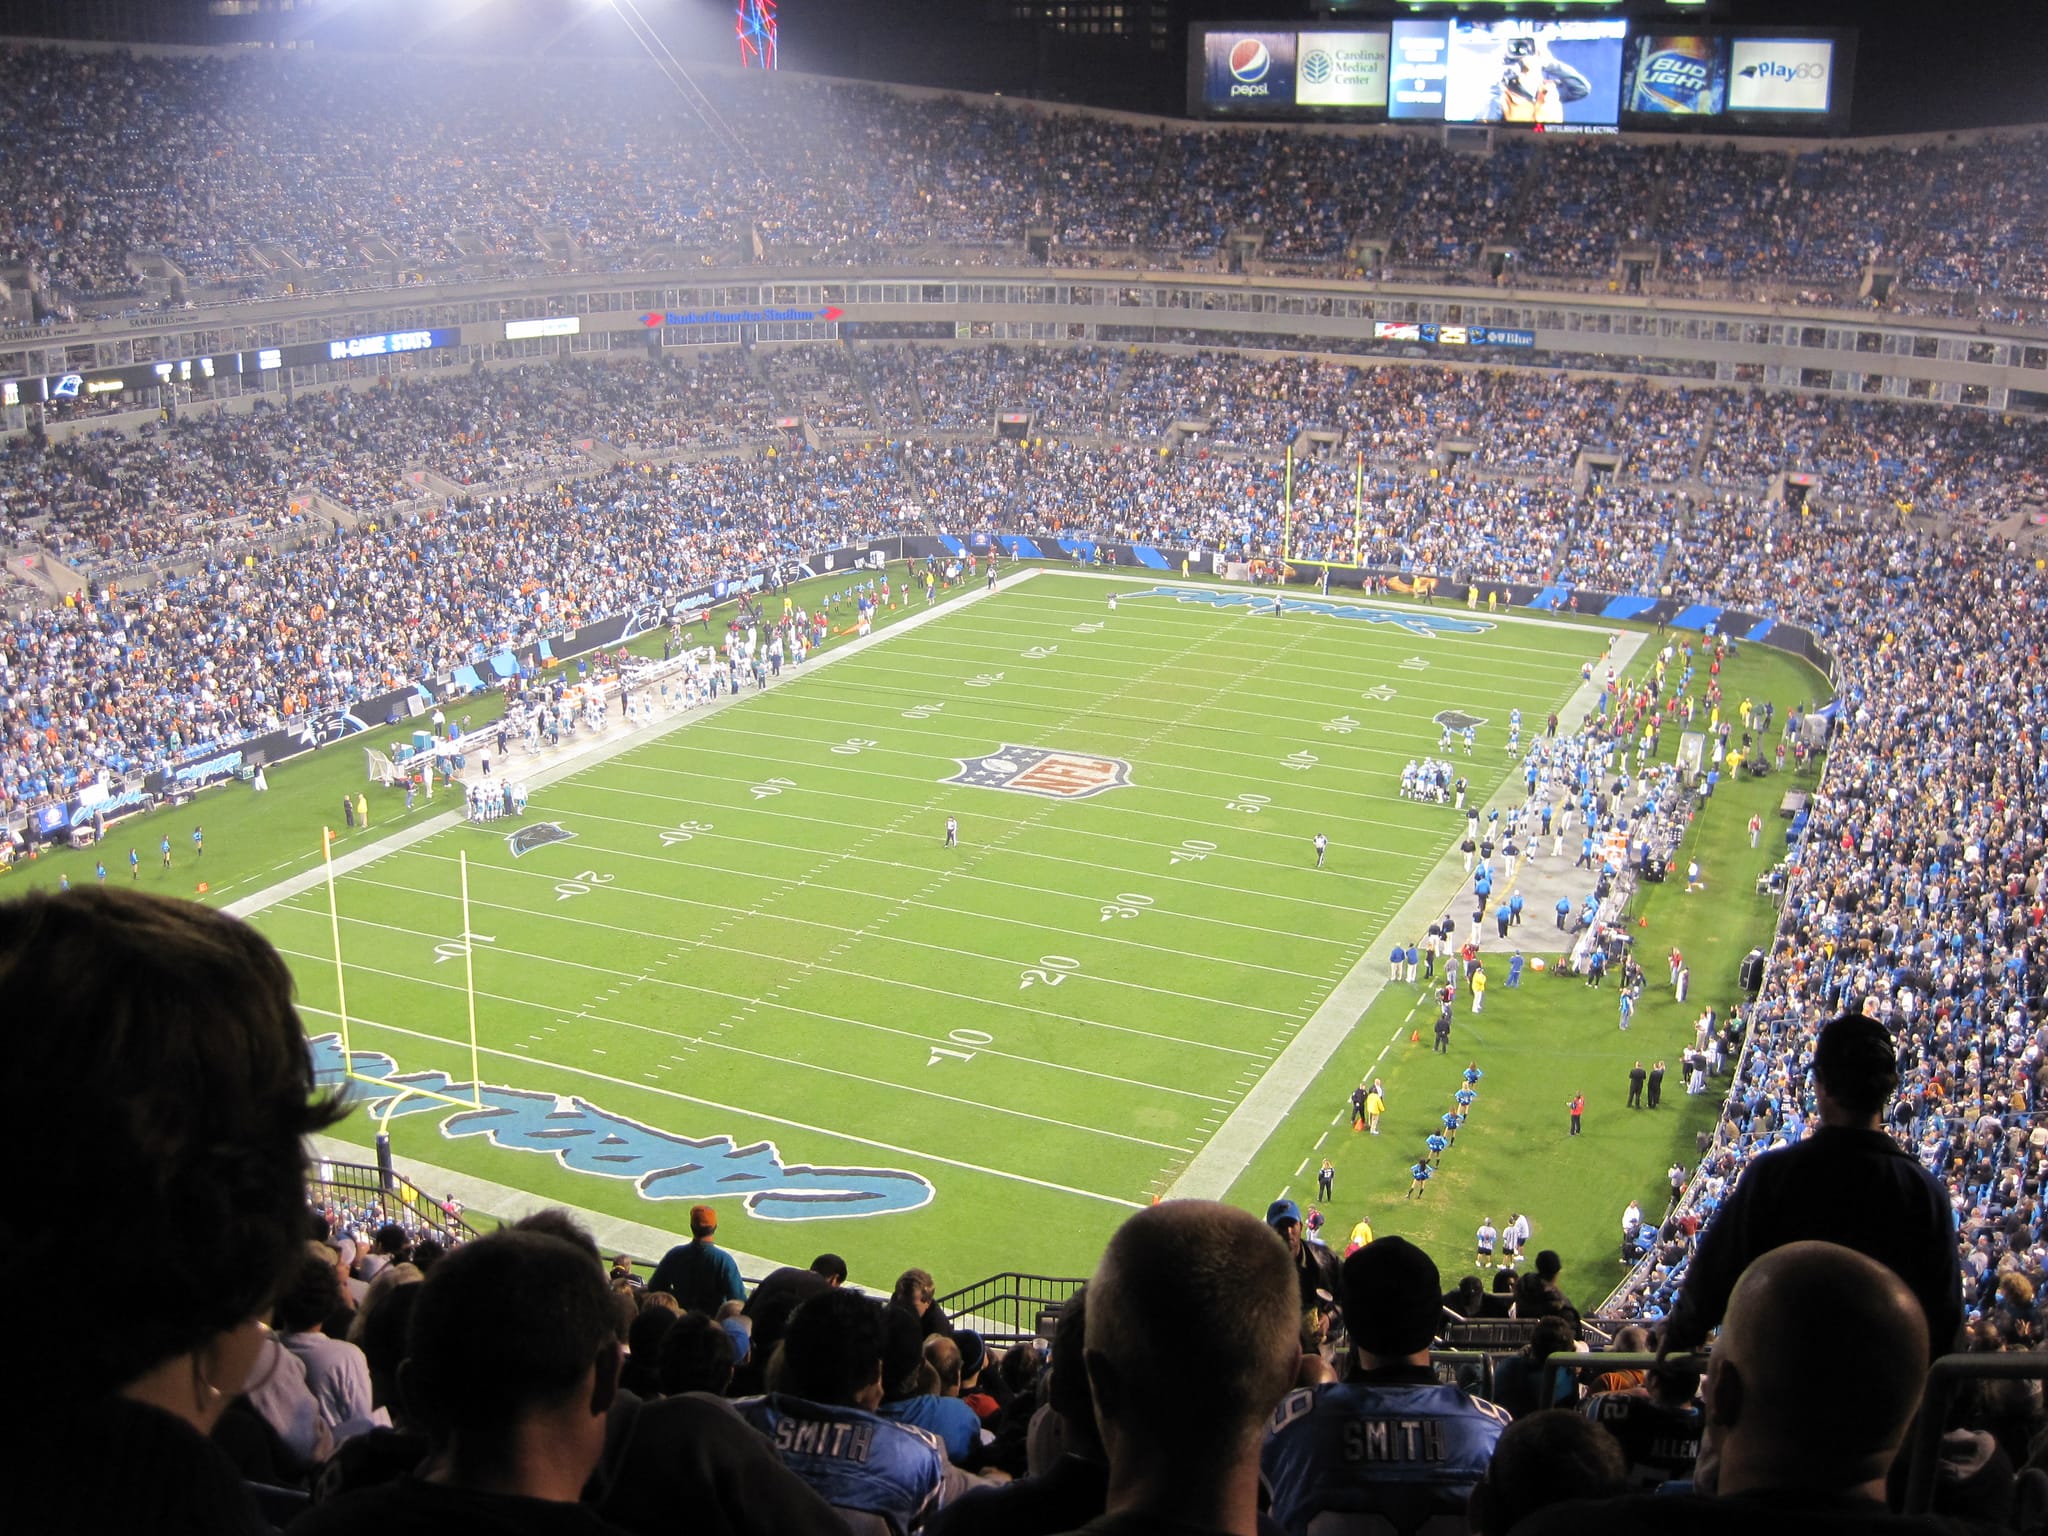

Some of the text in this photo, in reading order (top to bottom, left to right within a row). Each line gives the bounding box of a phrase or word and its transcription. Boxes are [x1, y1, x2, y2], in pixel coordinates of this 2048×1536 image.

[1335, 50, 1385, 61] Carolinas
[1335, 62, 1378, 73] Medical
[1652, 58, 1707, 78] BUD
[1231, 83, 1269, 97] pepsi
[1335, 75, 1369, 85] Center
[1643, 70, 1708, 90] LIGHT
[666, 311, 699, 325] Bank
[713, 310, 762, 324] America
[764, 308, 815, 321] Stadium
[1506, 332, 1534, 345] Blue
[1361, 686, 1397, 701] 20
[1322, 718, 1361, 734] 30
[830, 737, 878, 755] 50
[1280, 752, 1319, 771] 40
[750, 776, 798, 796] 40
[1009, 759, 1115, 795] NFL
[1225, 793, 1272, 814] 50
[659, 820, 714, 843] 30
[1168, 840, 1217, 862] 40
[554, 869, 616, 897] 20
[1100, 893, 1154, 919] 30
[1020, 955, 1081, 986] 20
[929, 1028, 994, 1063] 10
[775, 1417, 874, 1463] SMITH
[1344, 1420, 1447, 1461] SMITH
